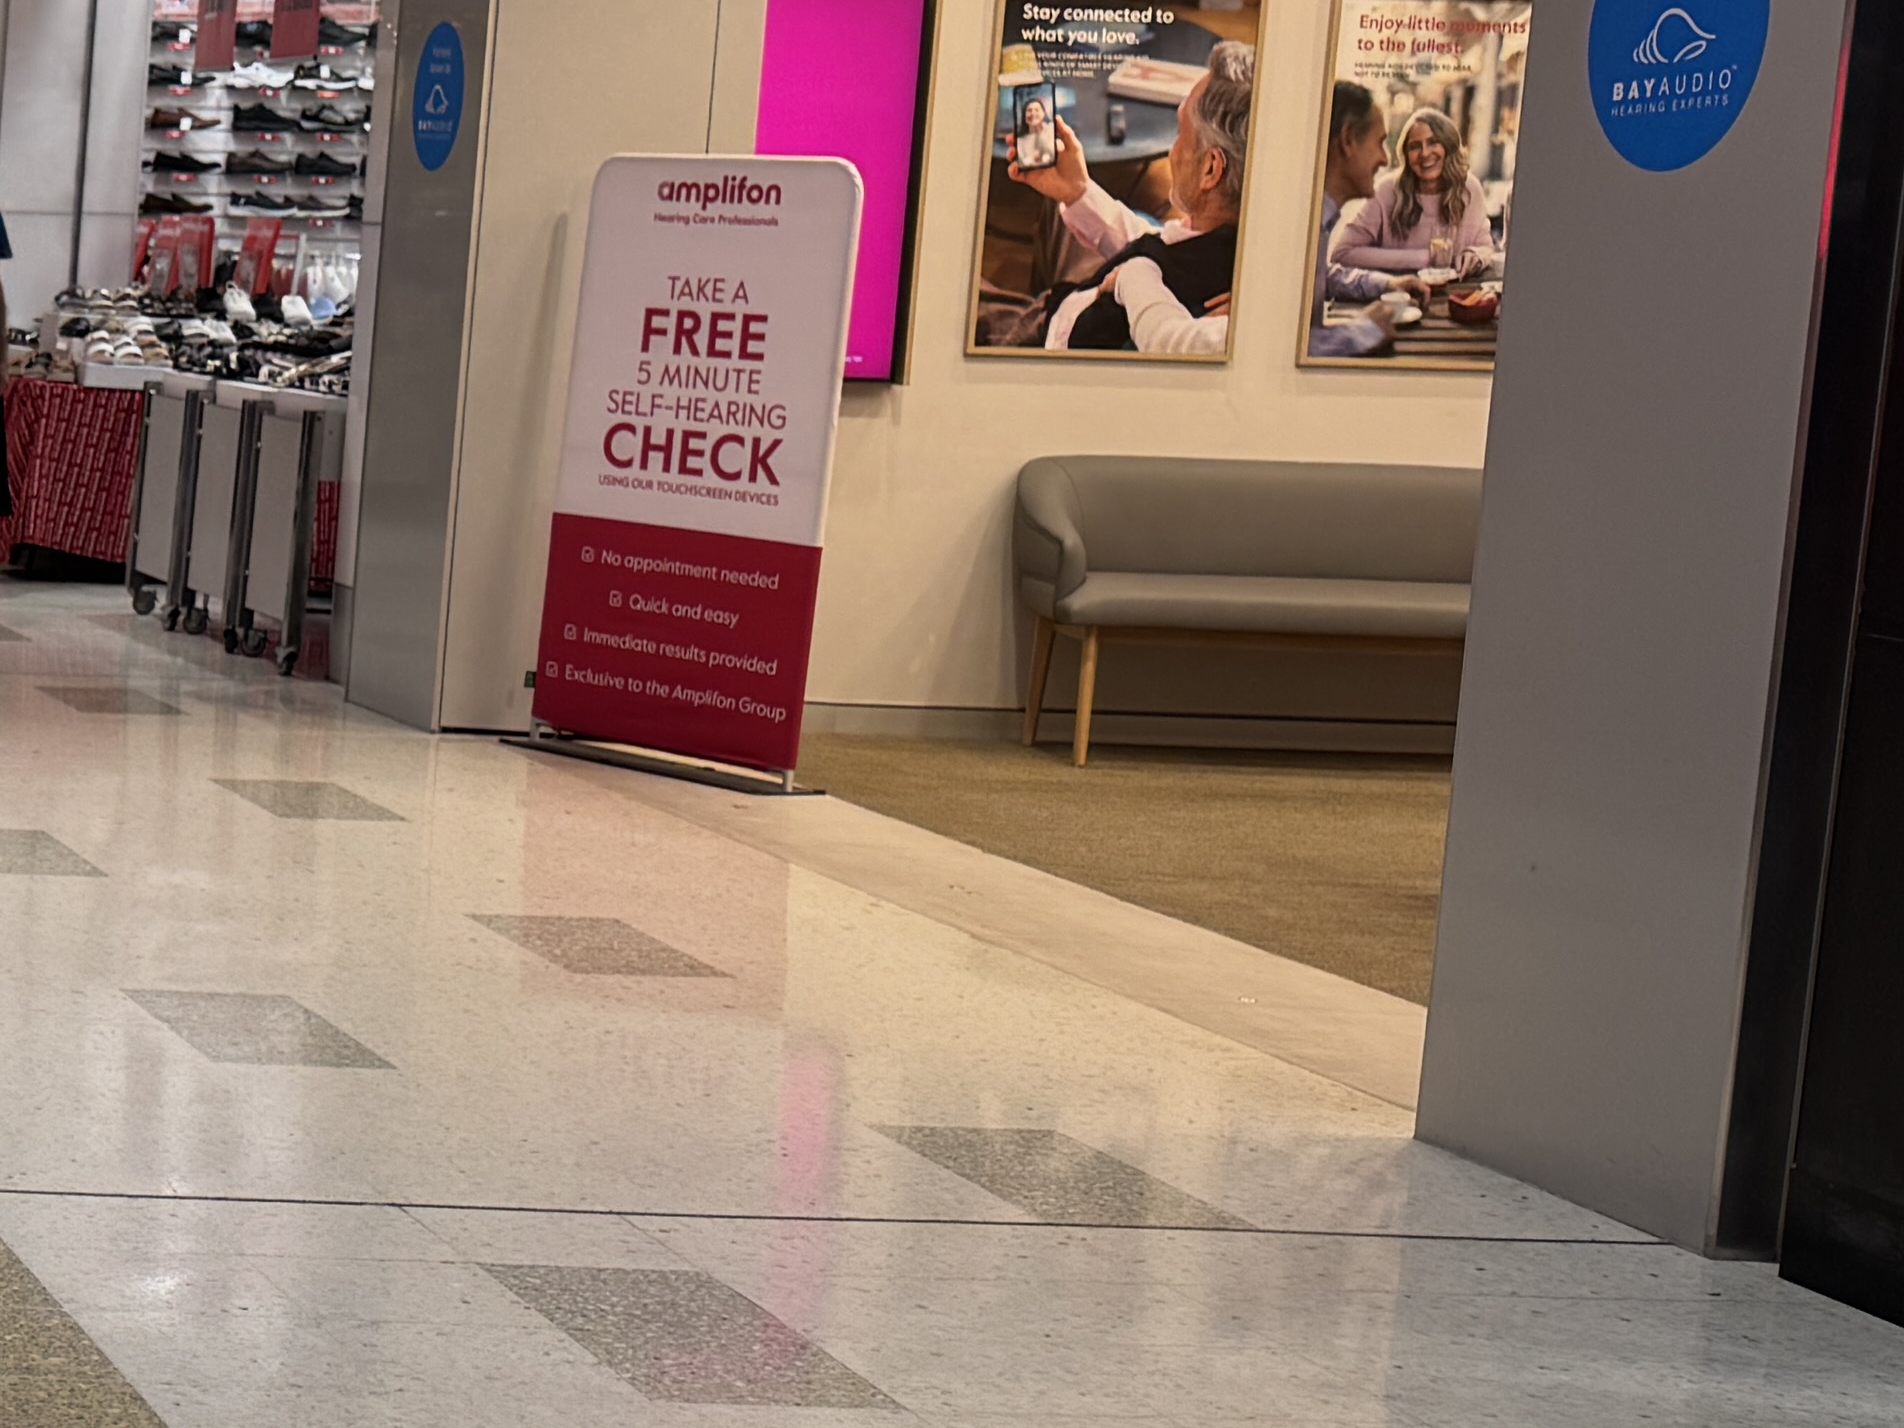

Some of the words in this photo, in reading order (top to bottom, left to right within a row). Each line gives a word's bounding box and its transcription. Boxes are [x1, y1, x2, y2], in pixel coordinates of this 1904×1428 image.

[1022, 2, 1061, 25] Stay
[1063, 6, 1153, 23] connected
[1156, 8, 1175, 24] to
[1359, 14, 1403, 33] Enjoy
[1407, 15, 1446, 32] little
[1021, 25, 1064, 43] what
[1068, 29, 1098, 46] you
[1102, 27, 1140, 45] love.
[1357, 38, 1375, 52] to
[1379, 36, 1406, 53] the
[1611, 100, 1665, 118] HEARING
[1672, 94, 1730, 112] EXPERTS
[657, 175, 782, 211] amplifon
[654, 212, 691, 226] Hearing
[693, 213, 716, 225] Care
[718, 214, 779, 227] Professionals
[667, 276, 726, 304] TAKE
[731, 280, 750, 304] A
[640, 307, 769, 362] FREE
[636, 360, 652, 385] 5
[659, 363, 762, 395] MINUTE
[606, 389, 788, 430] SELF-HEARING
[602, 422, 784, 487] CHECK
[598, 474, 630, 489] USING
[632, 476, 654, 491] OUR
[656, 479, 733, 501] TOUCHSCREEN
[734, 489, 779, 507] DEVICES
[601, 550, 622, 567] No
[624, 555, 717, 582] appointment
[720, 568, 780, 590] needed
[629, 593, 668, 616] Quick
[672, 603, 702, 620] and
[704, 610, 740, 629] easy
[583, 628, 656, 655] Immediate
[659, 643, 706, 663] results
[709, 651, 777, 676] provided
[565, 664, 625, 690] Exclusive
[627, 676, 643, 693] to
[645, 680, 670, 698] the
[672, 684, 736, 710] Amplifon
[738, 696, 787, 723] Group
